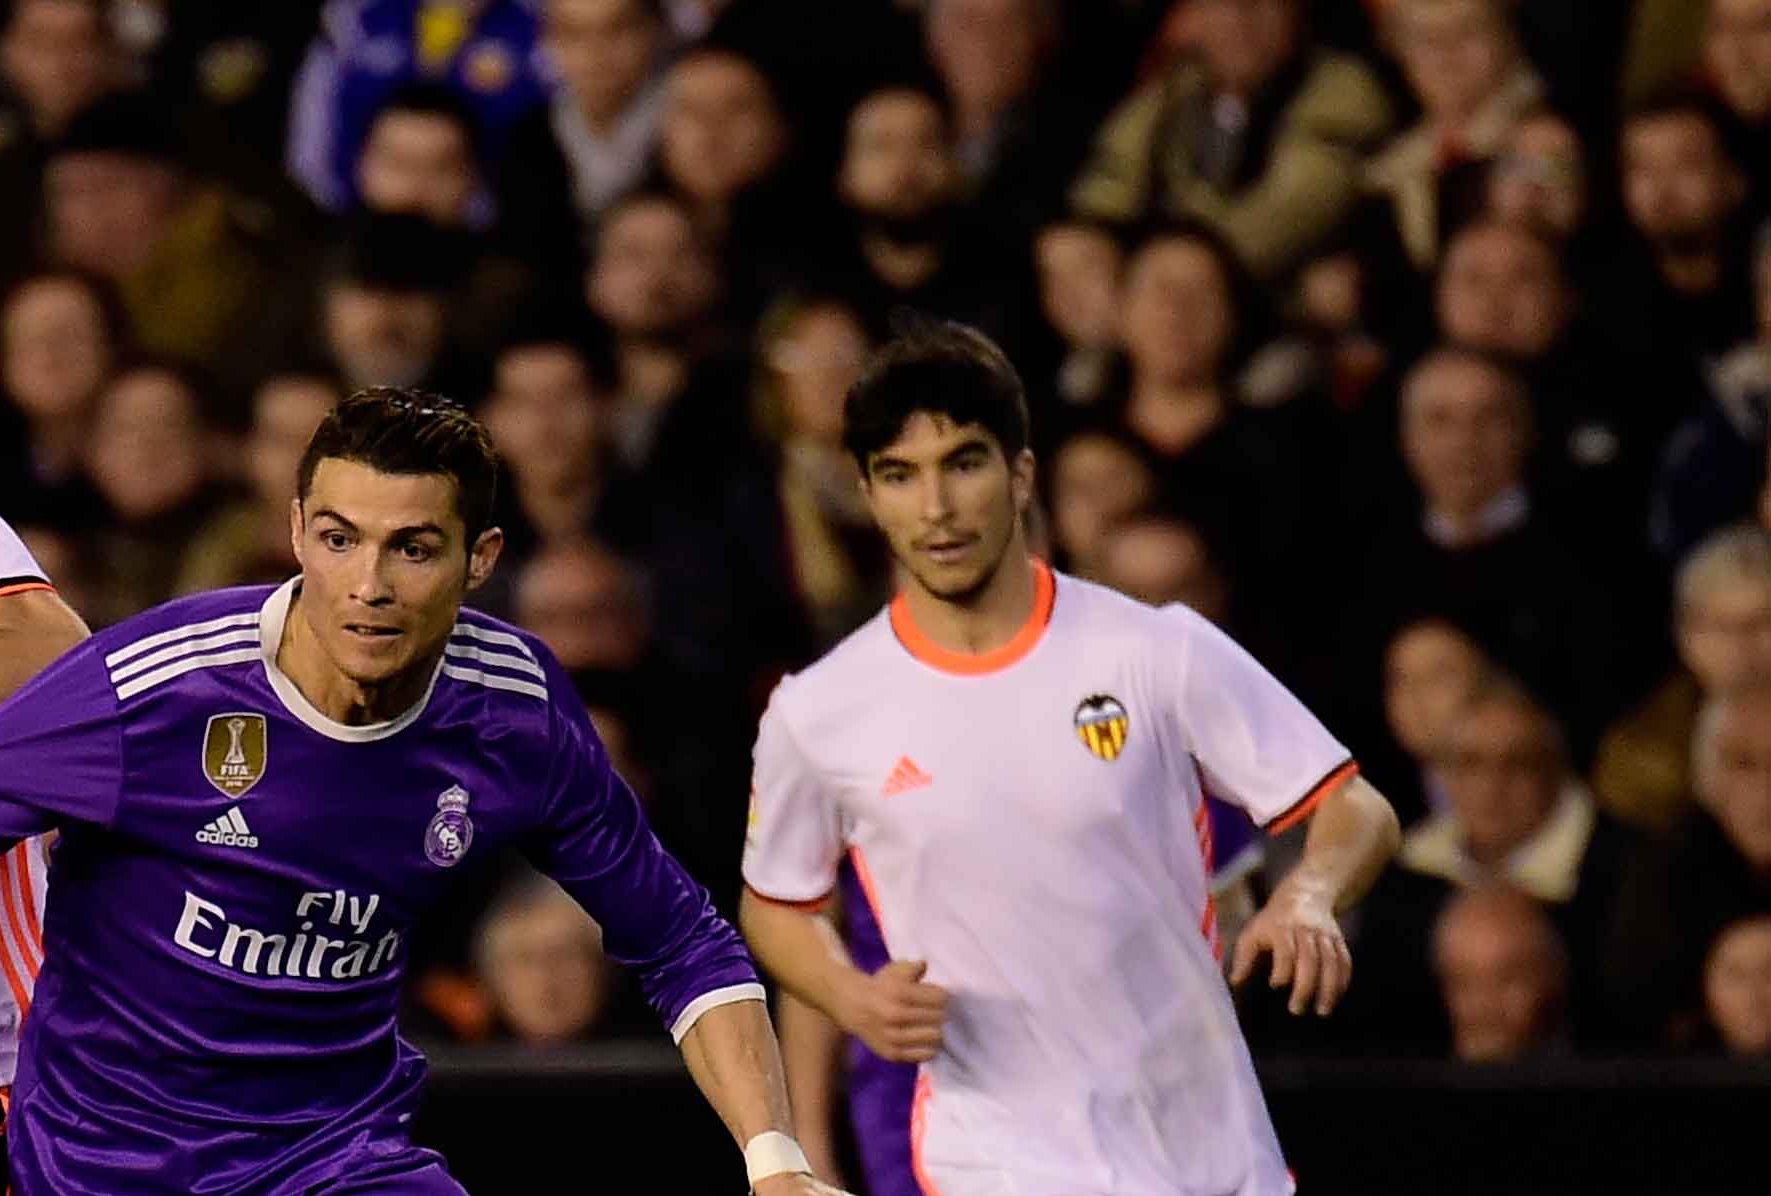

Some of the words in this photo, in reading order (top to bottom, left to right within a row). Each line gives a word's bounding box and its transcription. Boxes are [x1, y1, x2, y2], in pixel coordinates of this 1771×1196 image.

[220, 764, 249, 776] FIFA
[195, 829, 259, 848] adidas
[296, 889, 380, 934] Fly
